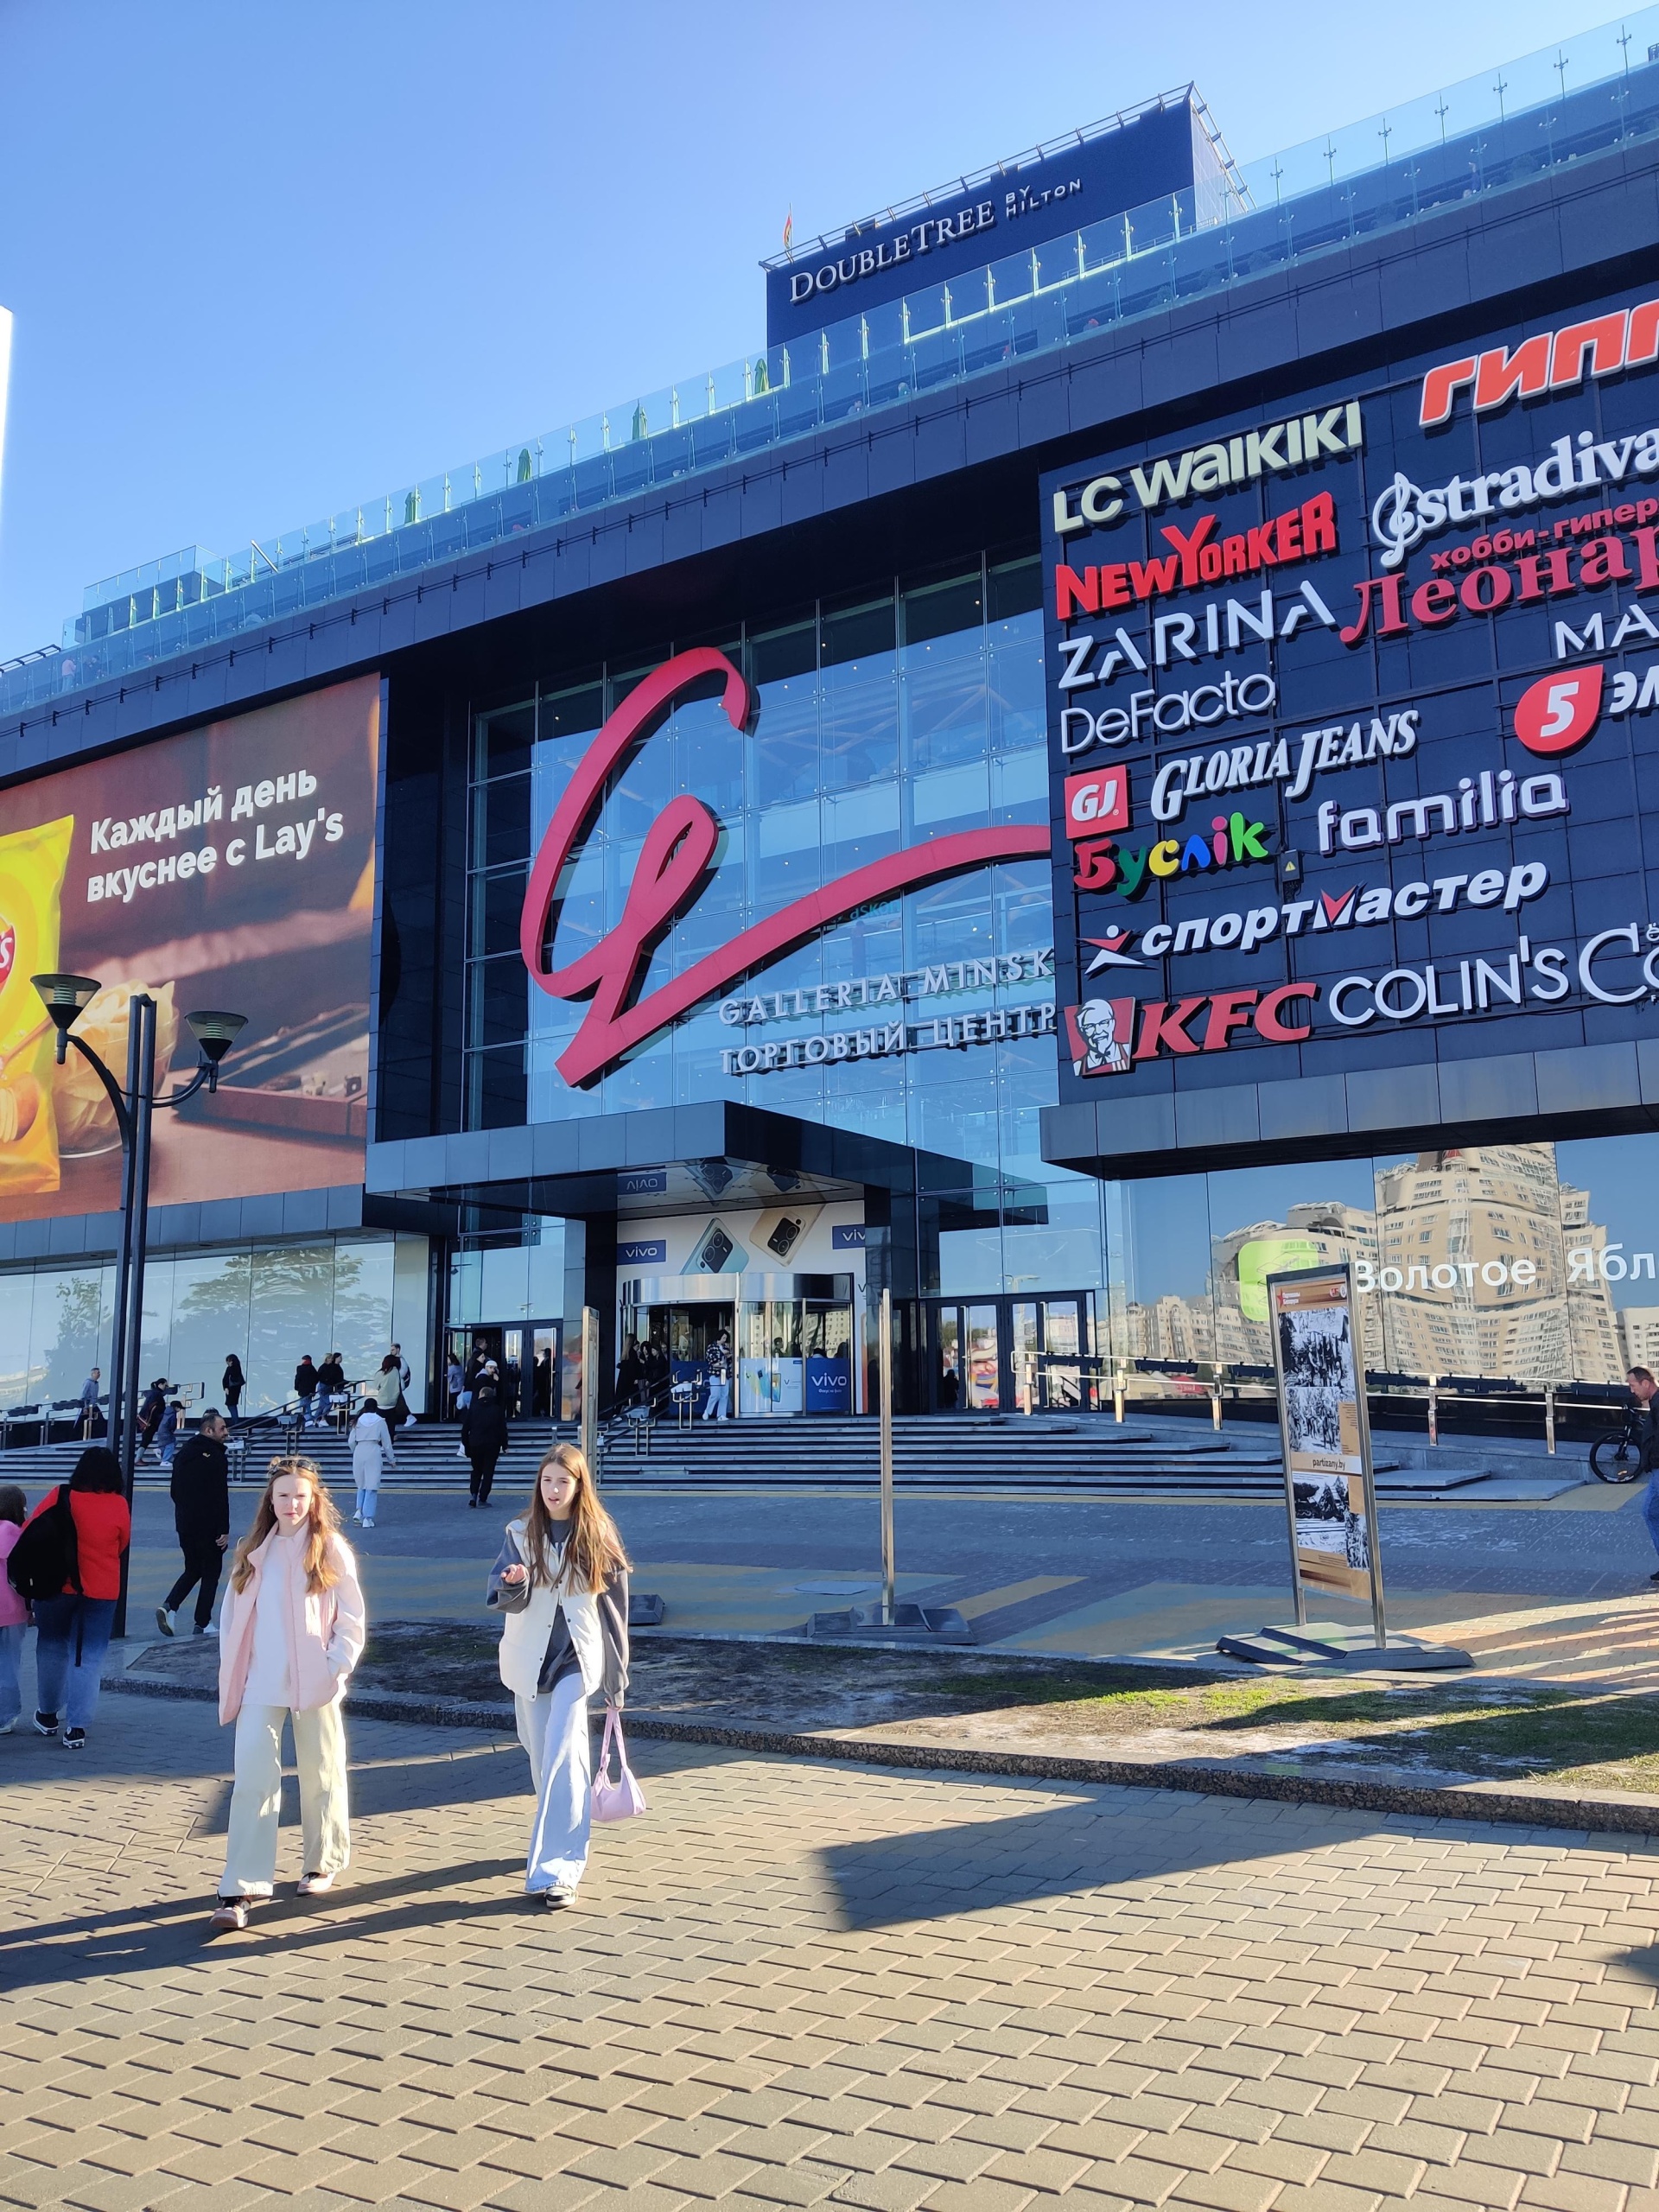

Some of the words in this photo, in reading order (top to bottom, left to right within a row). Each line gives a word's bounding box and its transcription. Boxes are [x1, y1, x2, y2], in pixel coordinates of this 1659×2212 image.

[1005, 178, 1083, 218] HILTON
[790, 200, 995, 304] DOUBLETREE
[1005, 185, 1032, 205] BY
[1053, 476, 1123, 533] LC
[1058, 580, 1336, 690] ZARINA
[1060, 671, 1276, 753] DeFacto
[1540, 681, 1580, 738] 5
[1071, 779, 1118, 822] GJ
[1150, 738, 1290, 821] GLORIA
[1285, 709, 1419, 798] JEANS
[90, 785, 223, 854] Каждый
[231, 769, 317, 822] день
[1318, 769, 1569, 855] familia
[86, 846, 217, 903] вкуснее
[226, 838, 245, 866] с
[255, 808, 344, 860] Lay's
[719, 974, 906, 1026] GALLERIA
[921, 949, 1055, 995] MINSK
[1329, 935, 1569, 1026] COLIN'S
[719, 1020, 906, 1075] ТОРГОВЫЙ
[933, 1002, 1056, 1047] ЦЕНТР
[1132, 982, 1318, 1059] KFC
[626, 1246, 658, 1258] vivo
[842, 1228, 866, 1242] viv
[1355, 1259, 1537, 1294] Золотое
[811, 1372, 847, 1387] vivo
[1313, 1458, 1346, 1471] partizany.by
